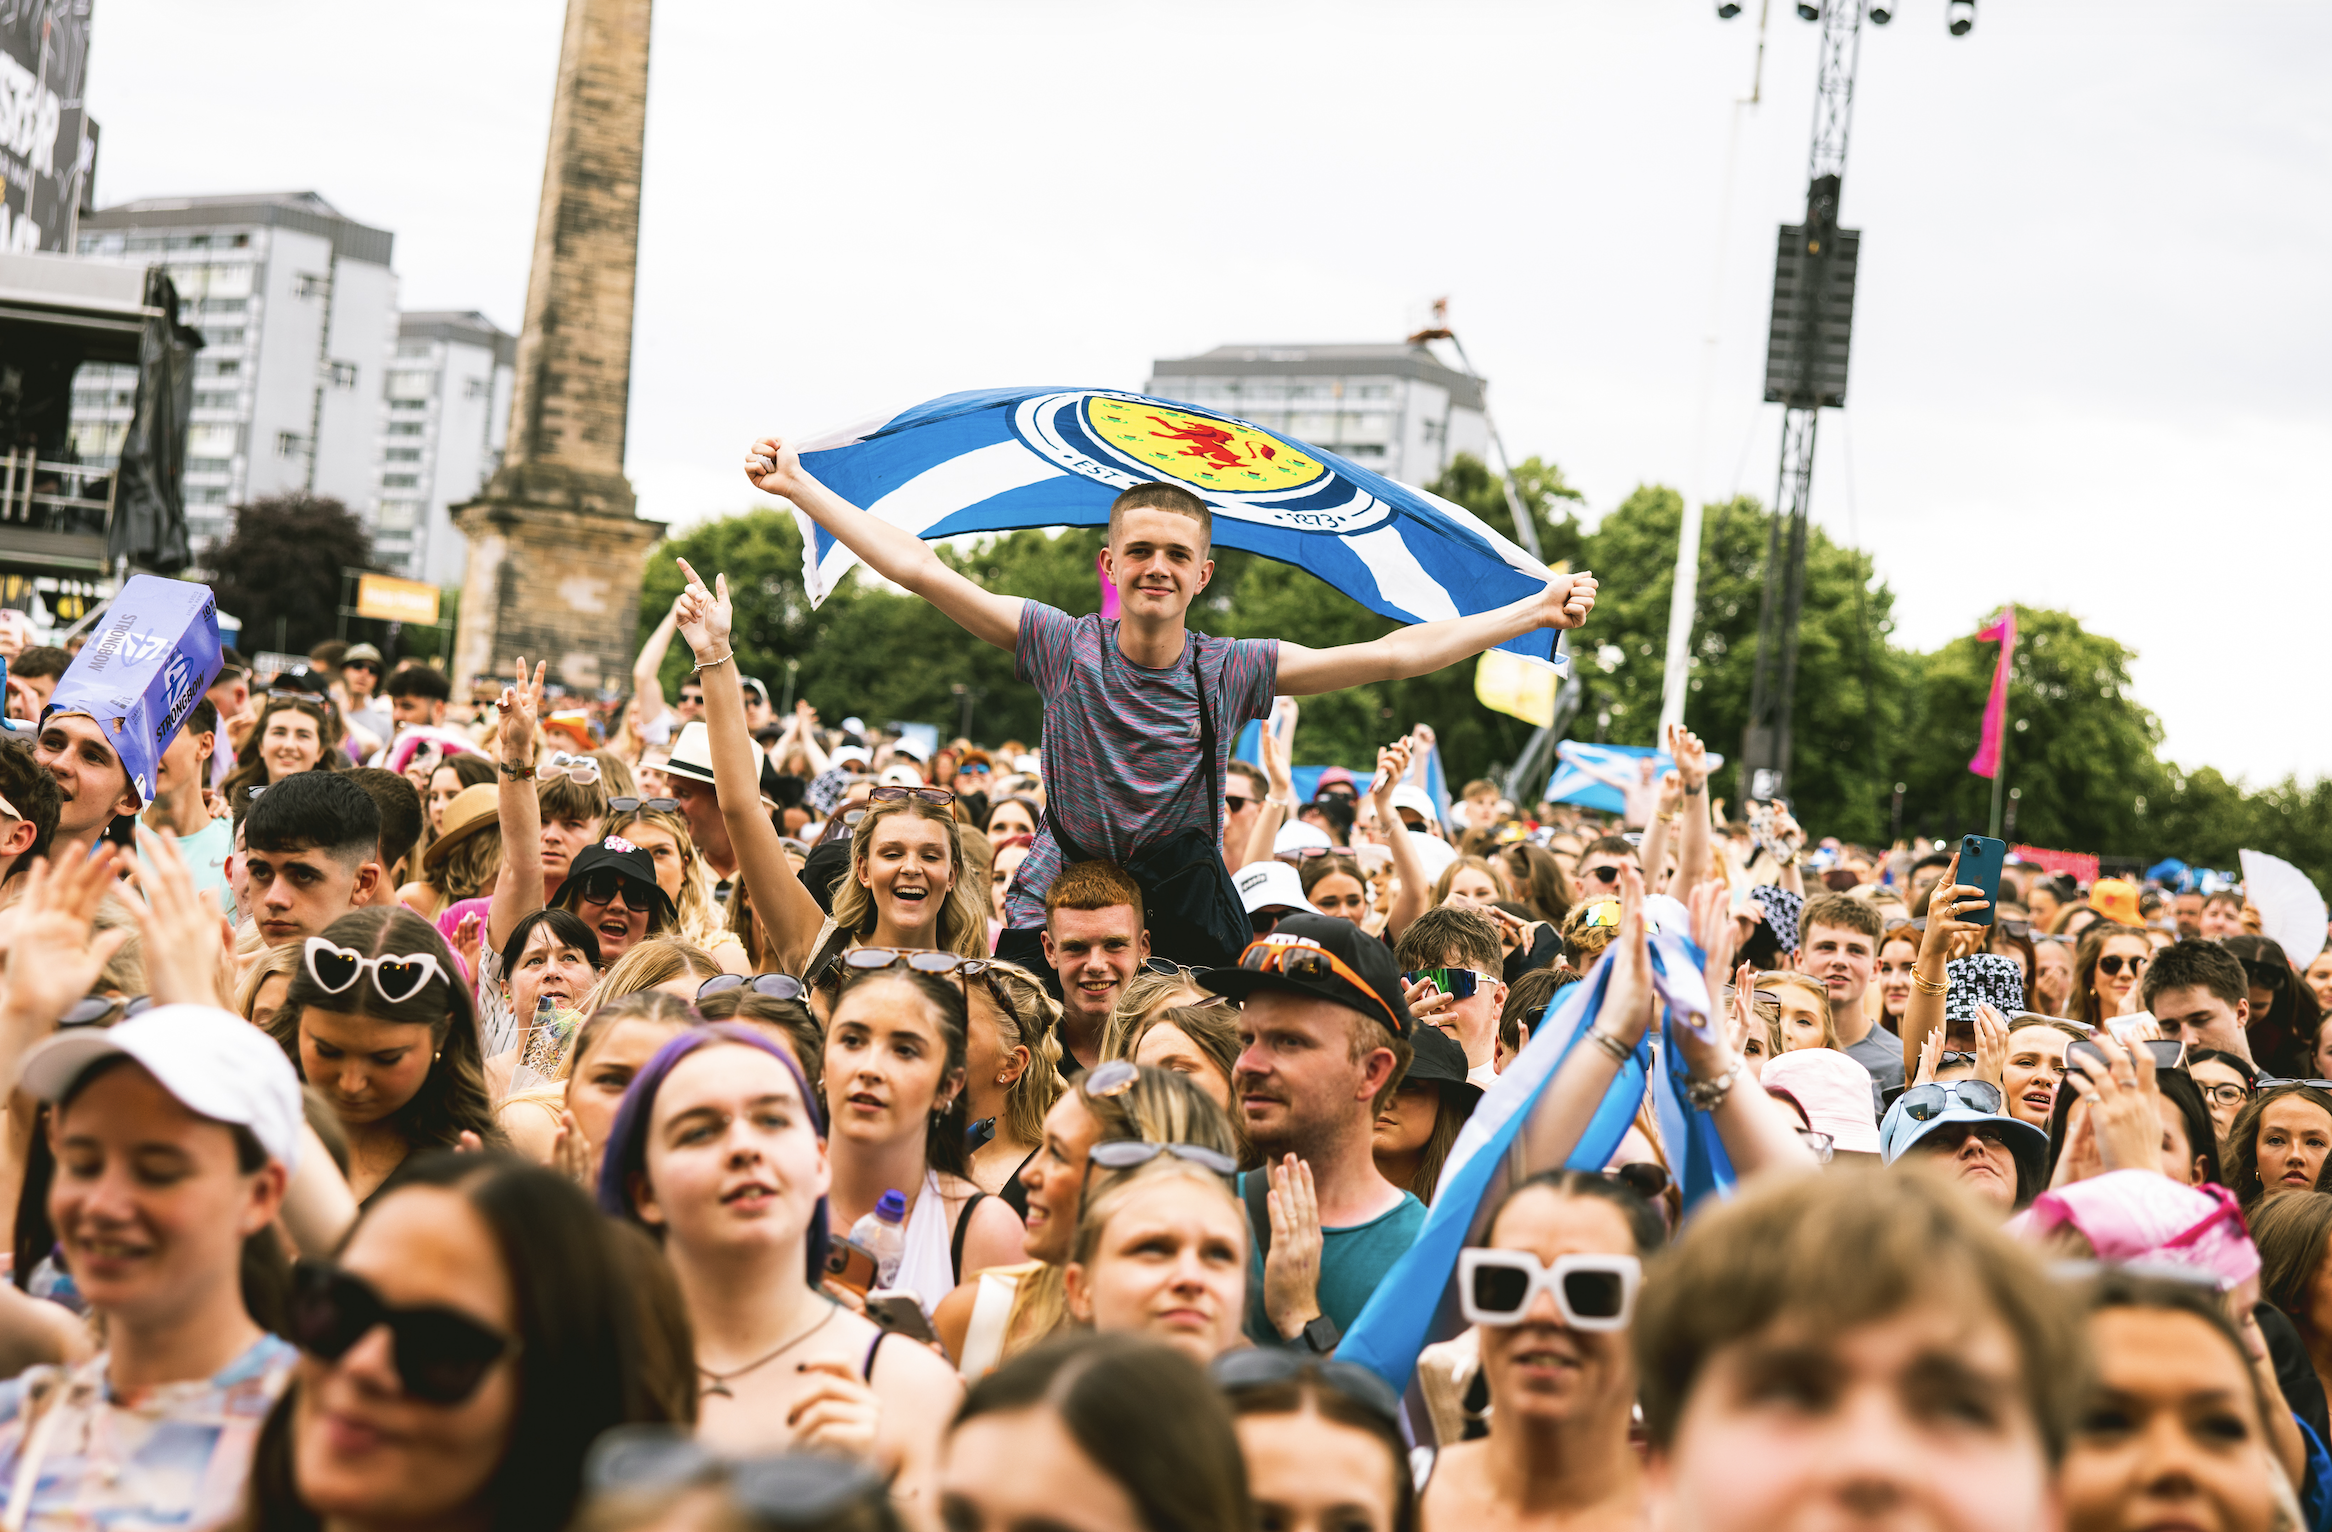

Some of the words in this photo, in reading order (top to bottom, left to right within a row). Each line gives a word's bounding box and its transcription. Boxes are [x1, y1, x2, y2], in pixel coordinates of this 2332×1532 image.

[1072, 460, 1122, 479] EST
[1286, 514, 1340, 528] 1873
[202, 605, 211, 619] 10
[88, 613, 138, 672] STRONGBOW
[156, 669, 205, 743] STRONGBOW
